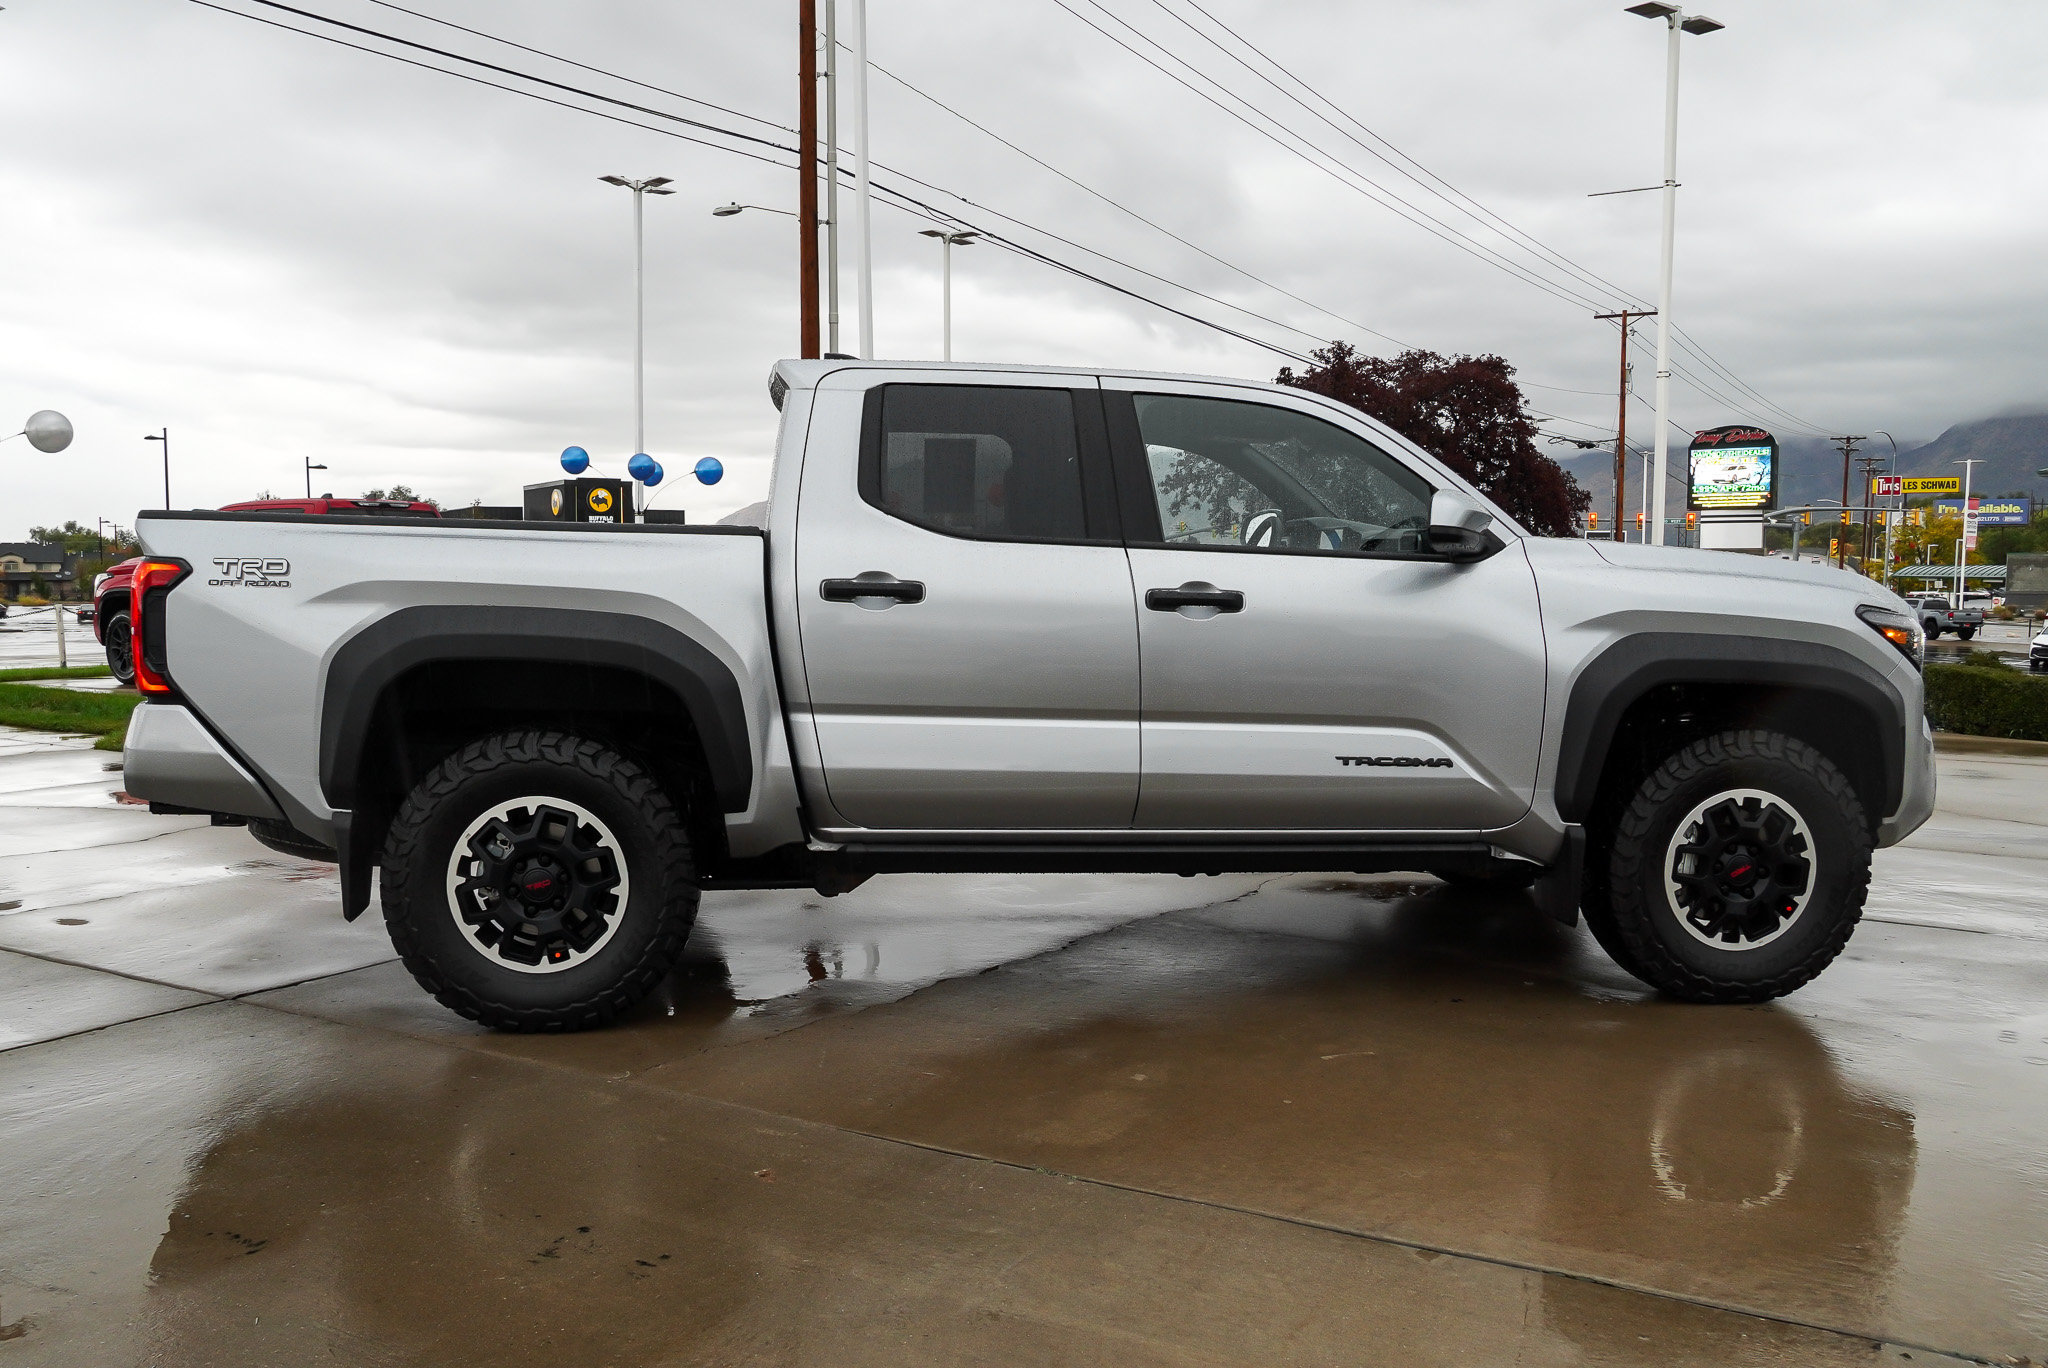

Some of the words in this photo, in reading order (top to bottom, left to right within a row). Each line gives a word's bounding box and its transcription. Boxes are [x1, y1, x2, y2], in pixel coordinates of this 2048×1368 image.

[1719, 484, 1739, 492] APR
[1741, 483, 1766, 492] 72mo
[1902, 481, 1918, 490] LES
[1920, 480, 1957, 490] SCHWAB
[212, 557, 290, 581] TRD
[244, 580, 291, 588] ROAD
[1335, 756, 1454, 768] TACOMA
[525, 879, 551, 890] TRD
